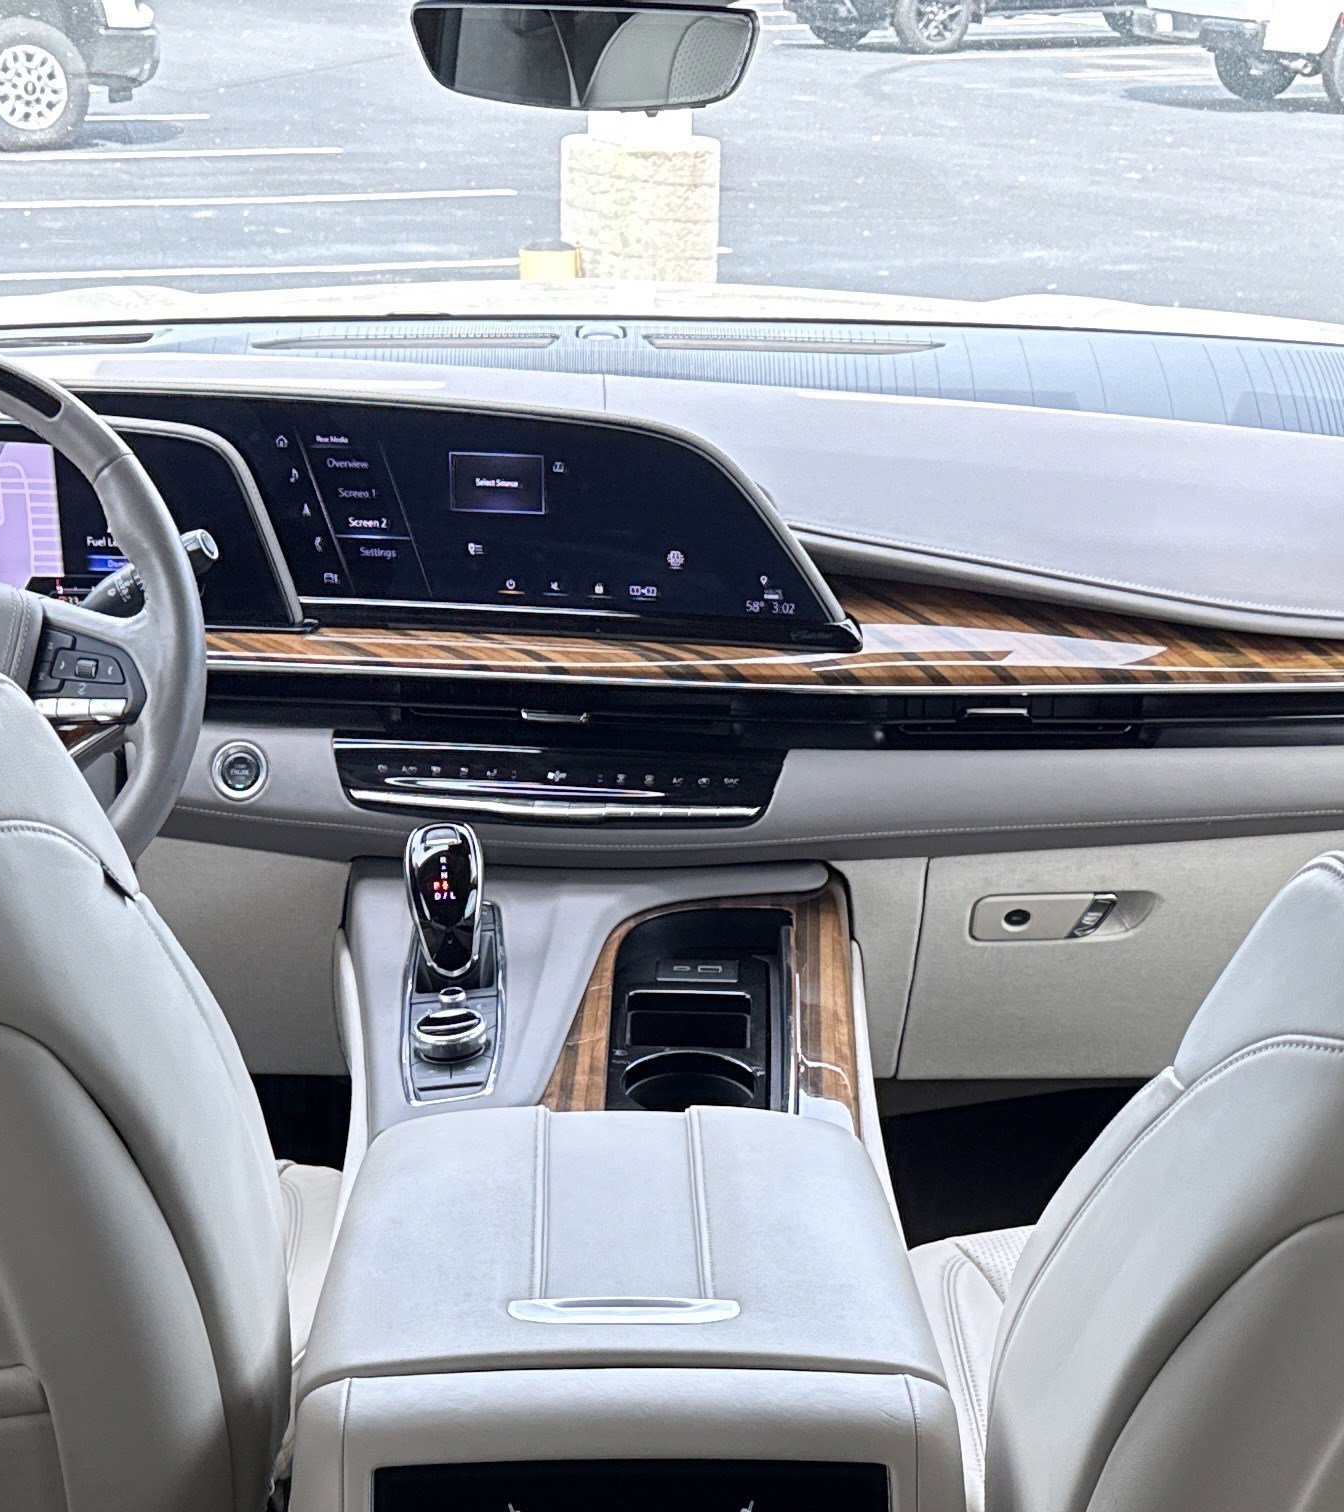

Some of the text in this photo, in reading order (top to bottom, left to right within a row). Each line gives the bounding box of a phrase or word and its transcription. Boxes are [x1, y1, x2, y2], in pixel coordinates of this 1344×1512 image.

[326, 457, 369, 469] Overview
[338, 487, 369, 499] Screen
[348, 516, 388, 529] Screen 2
[86, 535, 106, 547] Fuel
[359, 546, 397, 560] Settings
